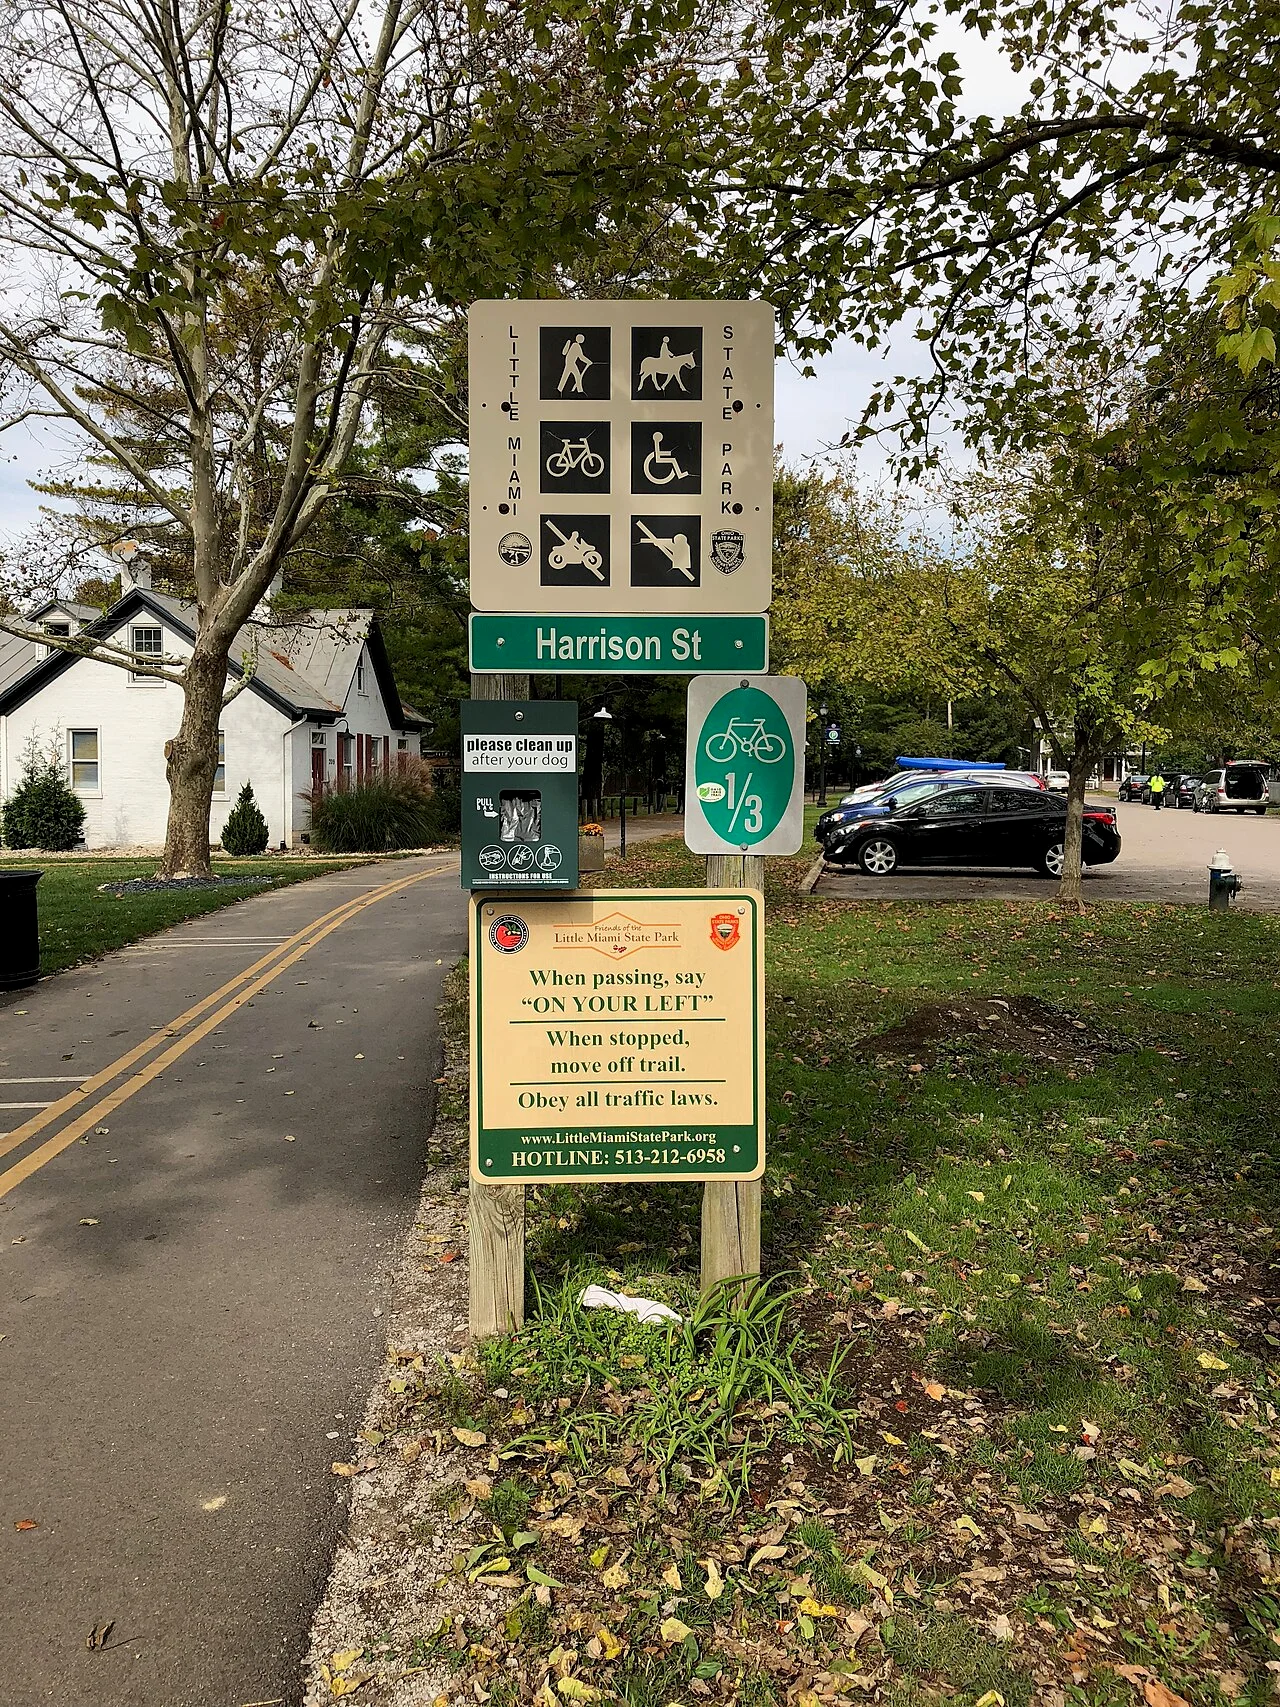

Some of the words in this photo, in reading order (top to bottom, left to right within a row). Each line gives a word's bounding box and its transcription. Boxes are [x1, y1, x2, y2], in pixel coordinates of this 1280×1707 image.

[508, 326, 520, 420] LITTLE
[722, 326, 734, 420] STATE
[508, 437, 521, 515] MIAMI
[721, 444, 732, 514] PARK
[536, 627, 662, 660] Harrison
[671, 628, 702, 660] St
[467, 738, 512, 752] please
[516, 738, 552, 751] clean
[556, 740, 572, 753] up
[472, 753, 503, 765] after
[507, 756, 538, 768] your
[542, 754, 568, 768] dog
[724, 772, 764, 834] 1/3
[554, 933, 584, 942] Little
[587, 933, 621, 942] Miami
[624, 932, 650, 942] State
[654, 932, 679, 942] Park
[530, 969, 586, 986] When
[592, 969, 669, 989] passing,
[675, 972, 706, 988] say
[522, 996, 565, 1013] “ON
[572, 996, 637, 1013] YOUR
[644, 995, 714, 1012] LEFT”
[546, 1030, 603, 1046] When
[609, 1029, 690, 1049] stopped,
[550, 1060, 602, 1074] move
[607, 1056, 635, 1073] off
[639, 1056, 686, 1073] trail.
[518, 1092, 569, 1112] Obey
[575, 1091, 598, 1107] all
[605, 1090, 665, 1107] traffic
[670, 1090, 718, 1106] laws.
[521, 1131, 717, 1145] www.LittleMiamiStatePark.org
[512, 1150, 610, 1167] HOTLINE:
[614, 1148, 726, 1166] 513-212-6958
